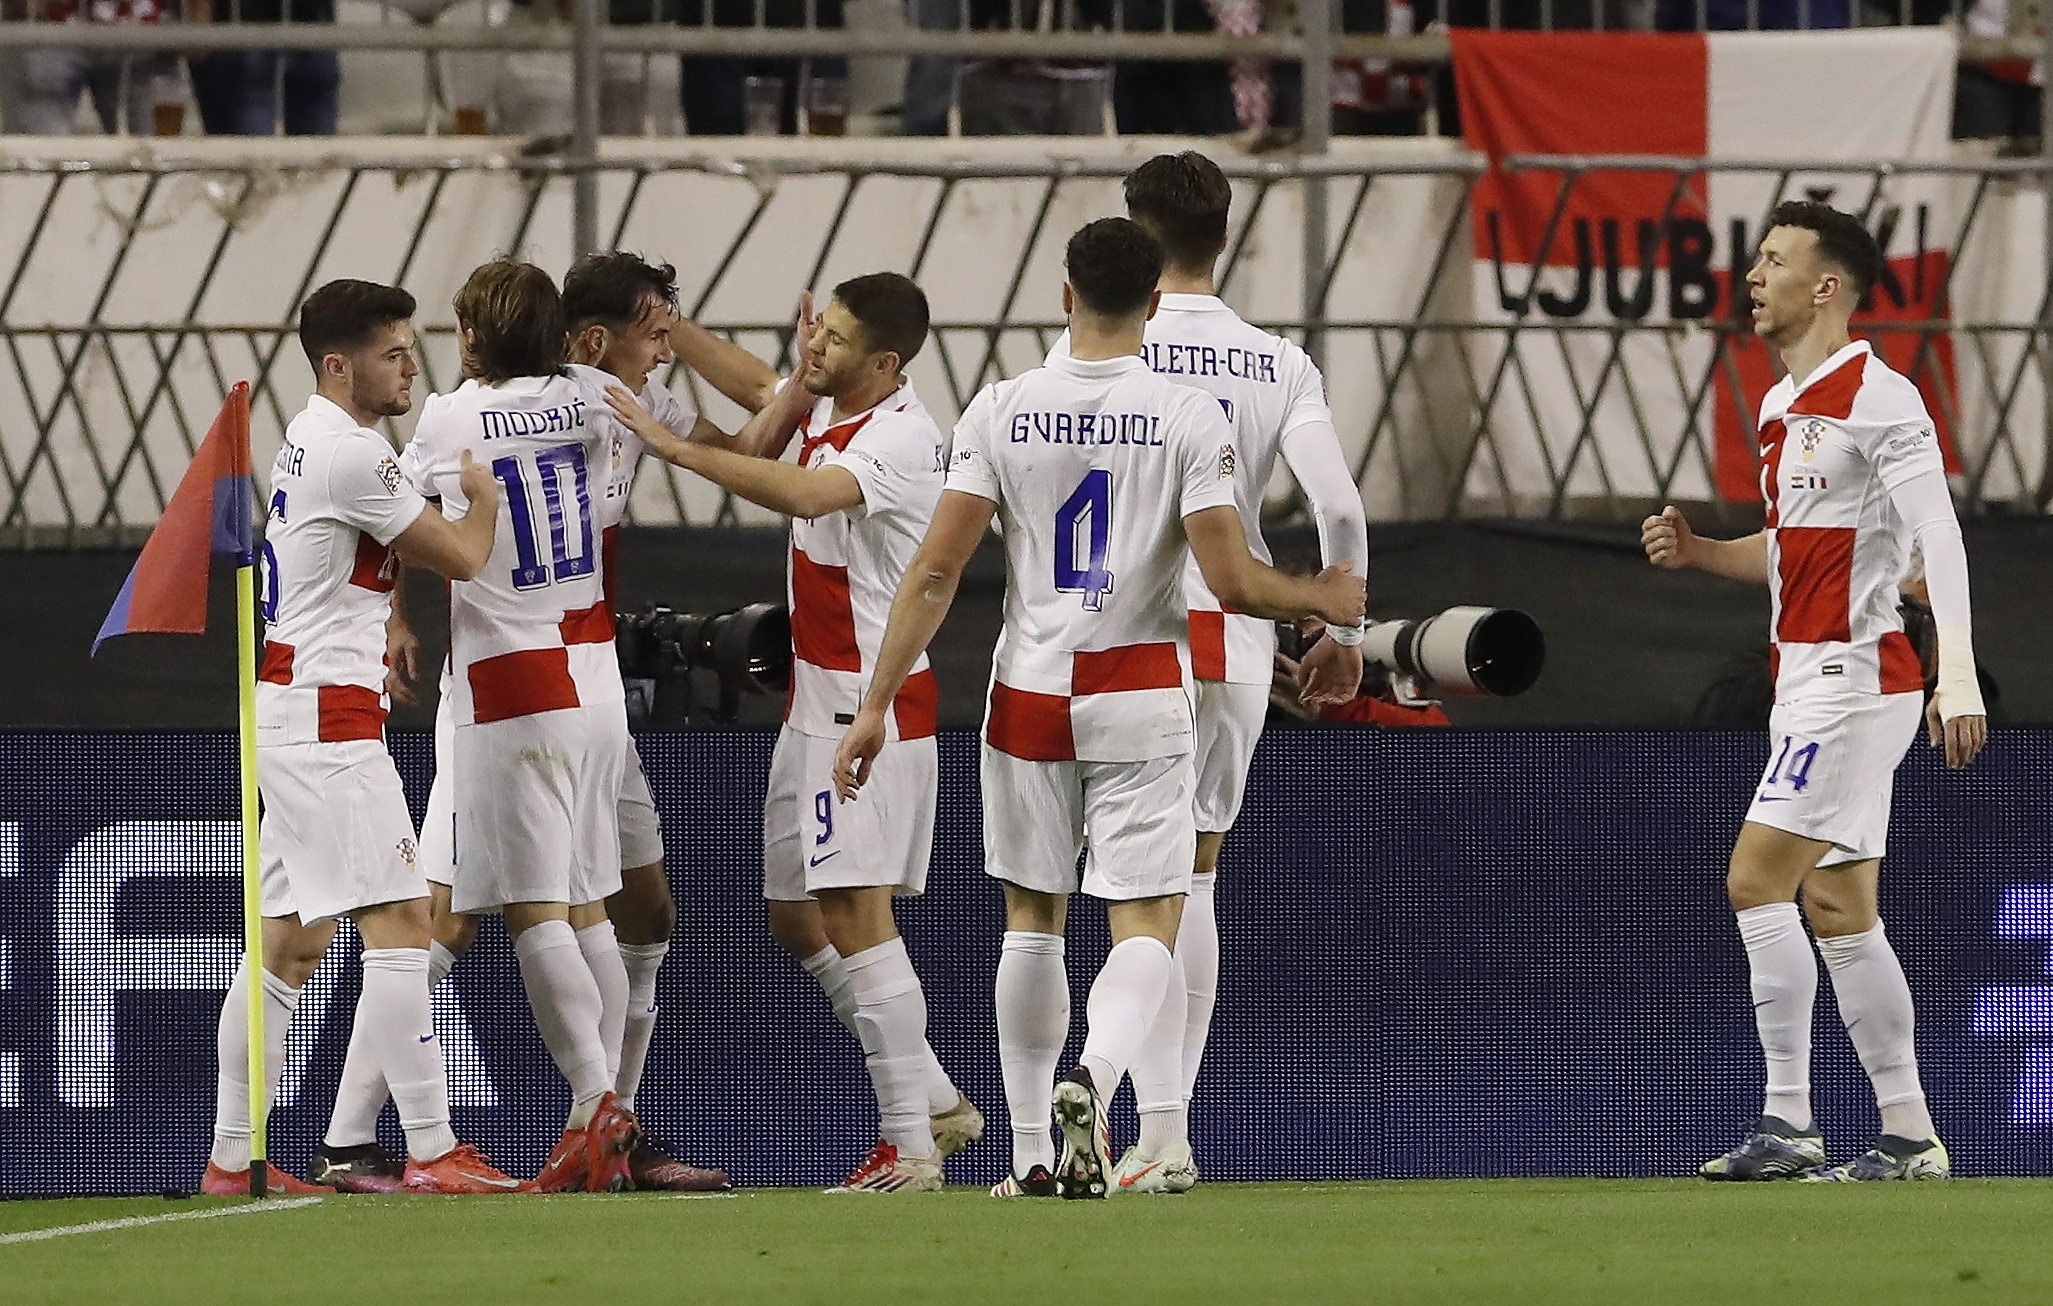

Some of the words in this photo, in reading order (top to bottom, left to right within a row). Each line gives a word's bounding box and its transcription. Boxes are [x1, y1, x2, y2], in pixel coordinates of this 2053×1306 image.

[1487, 187, 1928, 324] LJUBKI
[480, 397, 586, 440] MODRIĆ
[1011, 412, 1163, 446] GVARDIOL
[492, 443, 595, 592] 10
[1054, 469, 1114, 612] 4
[1767, 736, 1820, 793] 14
[815, 790, 833, 846] 9
